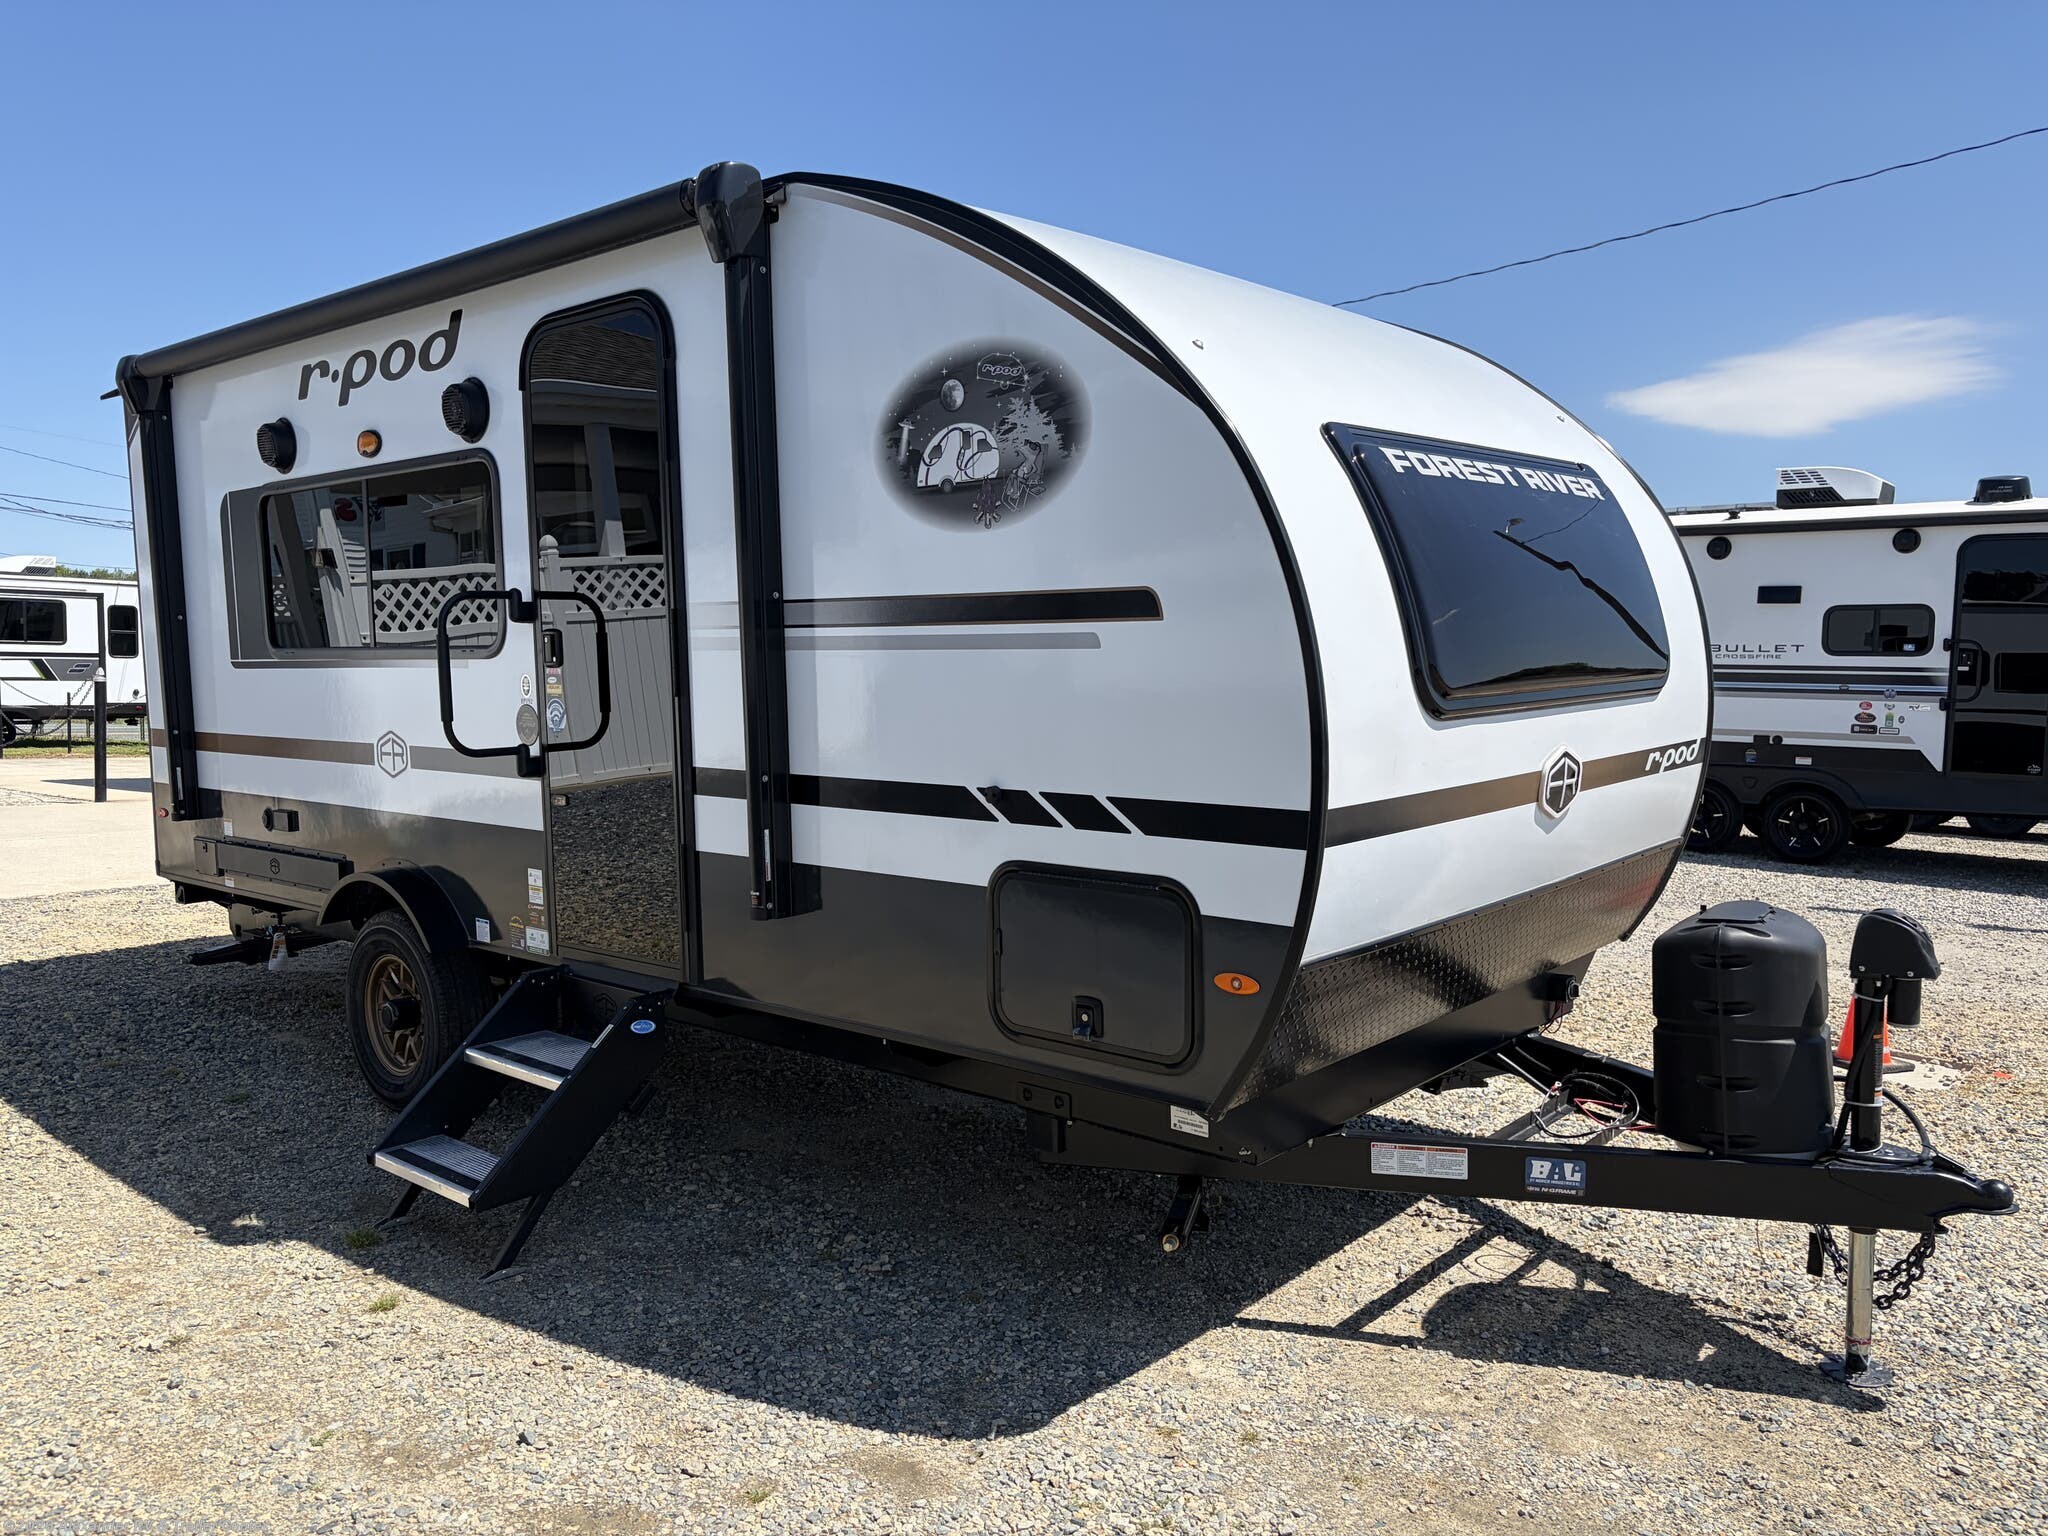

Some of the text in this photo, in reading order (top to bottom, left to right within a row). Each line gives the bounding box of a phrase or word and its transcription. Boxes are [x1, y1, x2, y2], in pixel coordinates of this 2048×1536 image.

[1378, 447, 1605, 501] FOREST RIVER
[1711, 644, 1805, 653] BULLET
